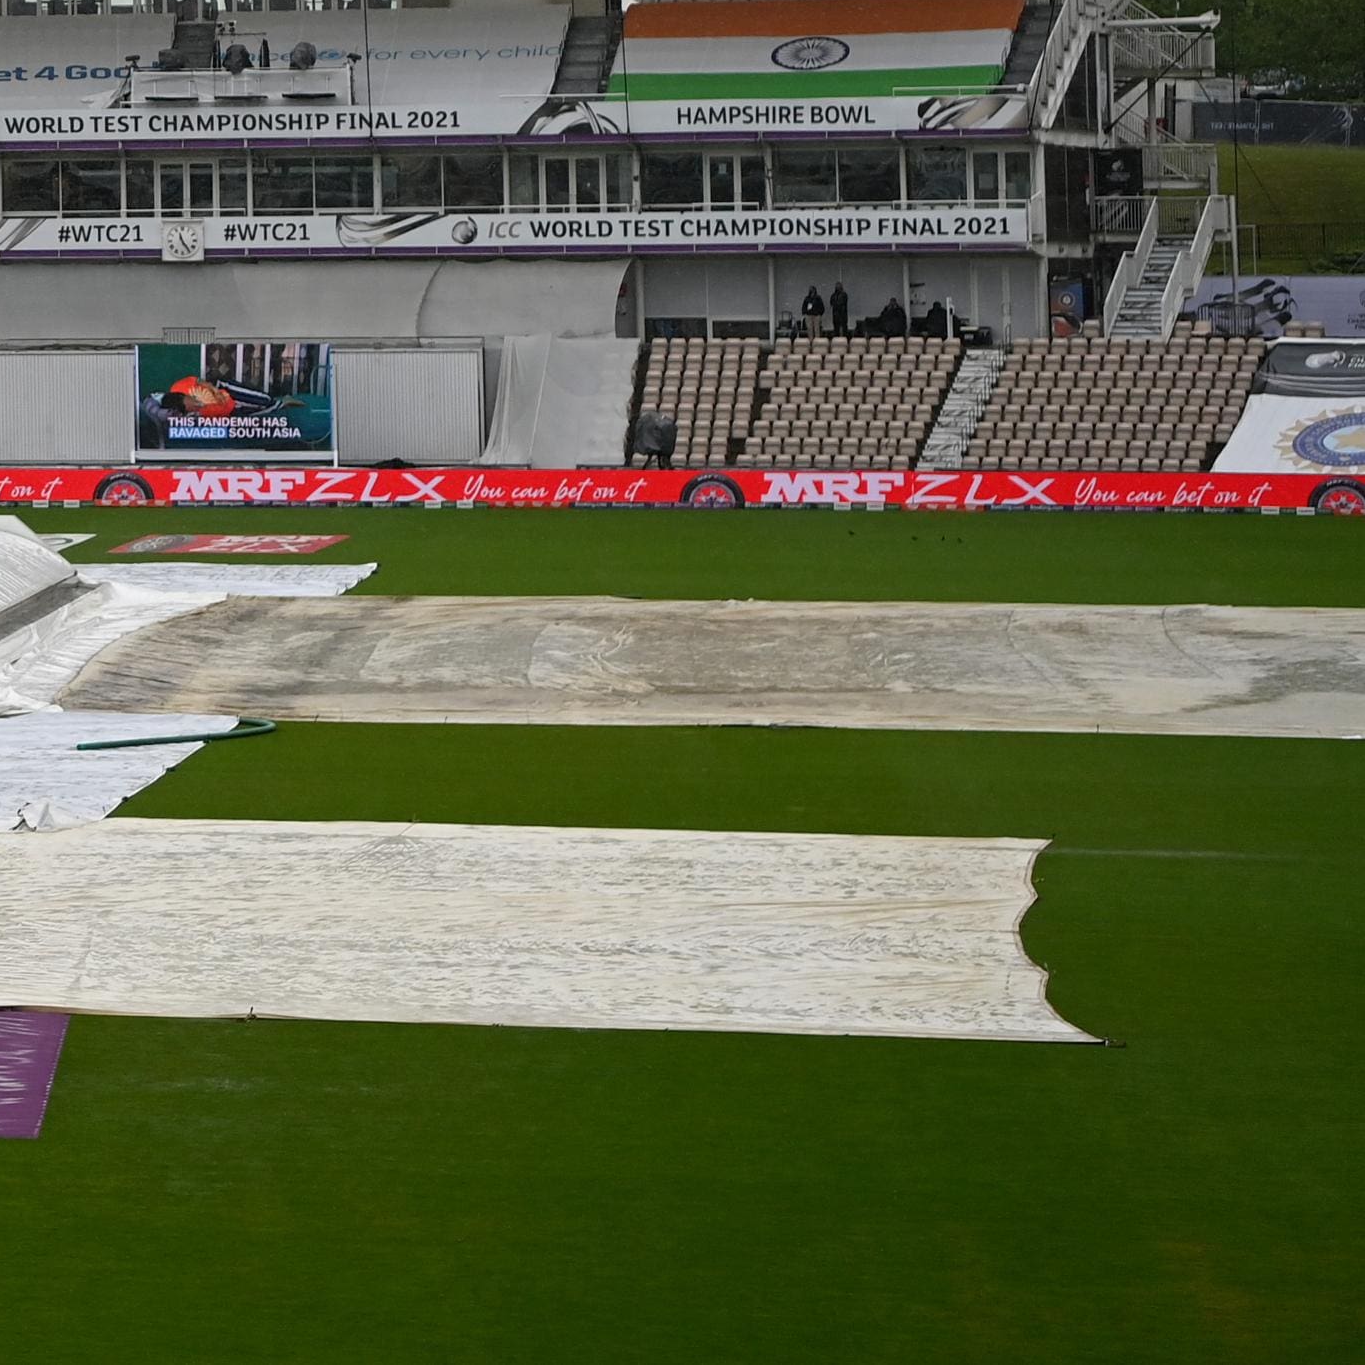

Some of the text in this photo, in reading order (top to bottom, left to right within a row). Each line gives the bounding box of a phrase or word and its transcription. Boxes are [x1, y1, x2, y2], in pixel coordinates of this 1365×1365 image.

[410, 49, 490, 61] every
[497, 45, 561, 59] child
[34, 65, 58, 80] 4
[5, 117, 84, 133] WORLD
[90, 116, 143, 132] TEST
[149, 113, 329, 132] CHAMPIONSHIP
[336, 113, 402, 129] FINAL
[407, 111, 460, 128] 2021
[677, 105, 876, 125] HAMPSHIRE BOWL
[58, 224, 143, 243] #WTC21
[224, 223, 311, 242] #WTC21
[488, 217, 1010, 238] ICC WORLD TEST CHAMPIONSHIP FINAL 2021
[168, 416, 287, 427] THIS PANDEMIC HAS
[169, 428, 301, 438] RAVAGED SOUTH ASIA
[10, 487, 35, 499] on
[39, 477, 63, 500] it
[170, 472, 305, 501] MRF
[462, 473, 505, 500] You
[511, 486, 547, 498] can
[554, 477, 593, 501] bet
[592, 487, 618, 499] on
[622, 476, 647, 501] it
[761, 472, 904, 503] MRF
[1074, 477, 1119, 506] You
[1125, 490, 1165, 503] can
[1172, 481, 1213, 506] bet
[1213, 490, 1240, 503] on
[1246, 480, 1272, 506] it
